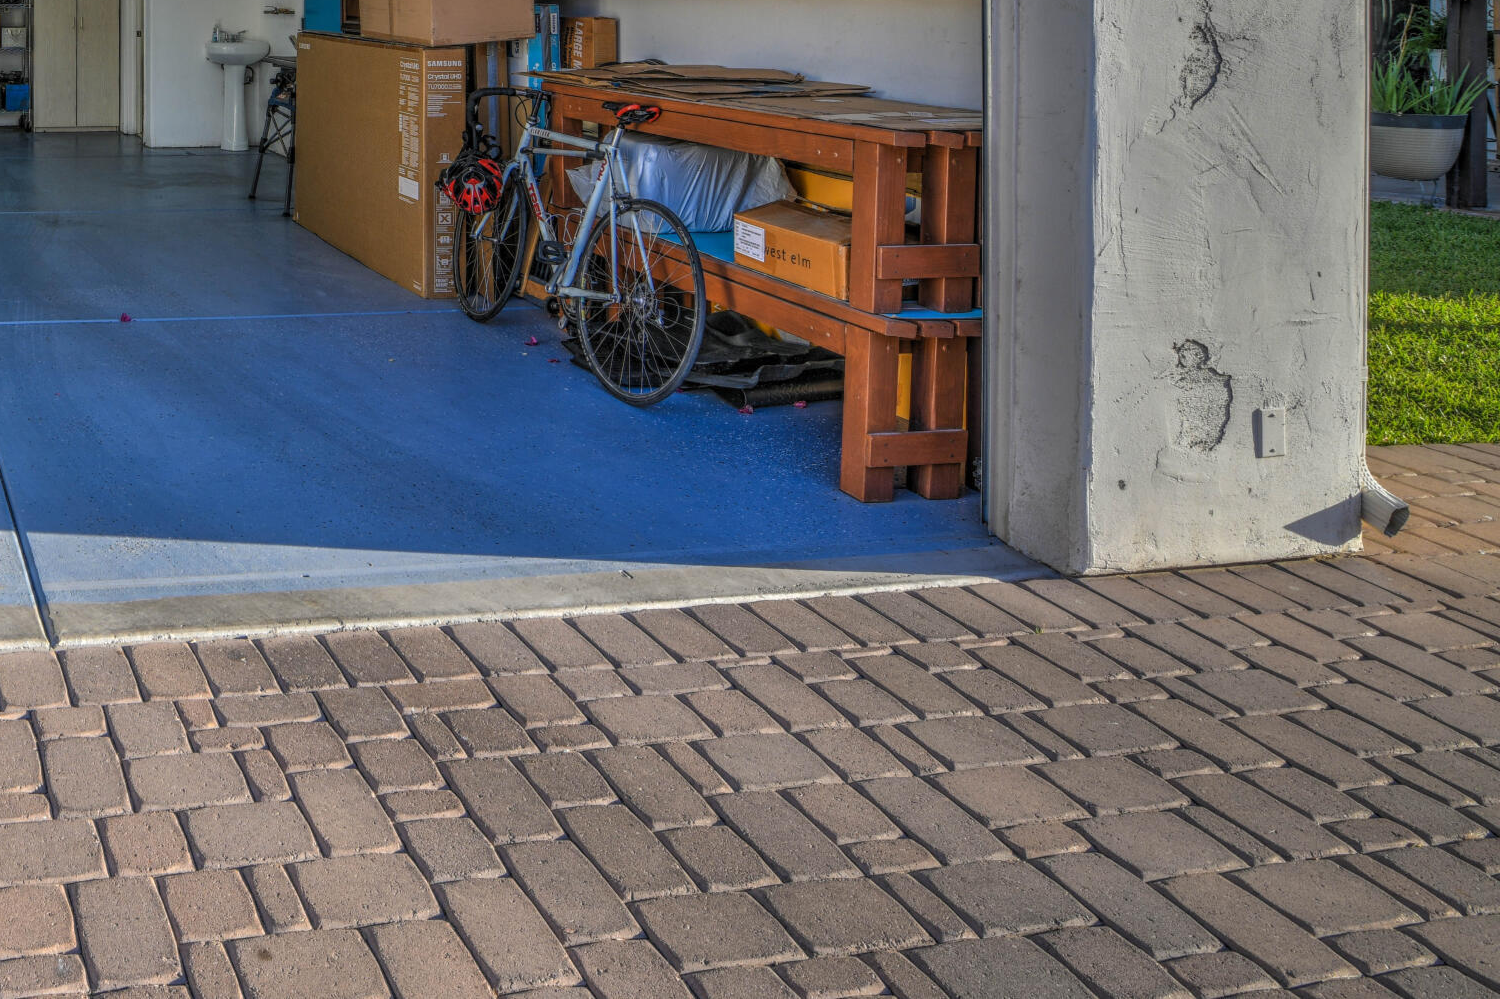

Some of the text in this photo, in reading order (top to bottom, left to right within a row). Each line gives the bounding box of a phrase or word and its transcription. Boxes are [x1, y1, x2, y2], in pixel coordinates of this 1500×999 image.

[572, 21, 584, 58] LARGE
[427, 73, 450, 81] Crystal
[528, 182, 544, 221] TREK
[790, 253, 811, 269] elm
